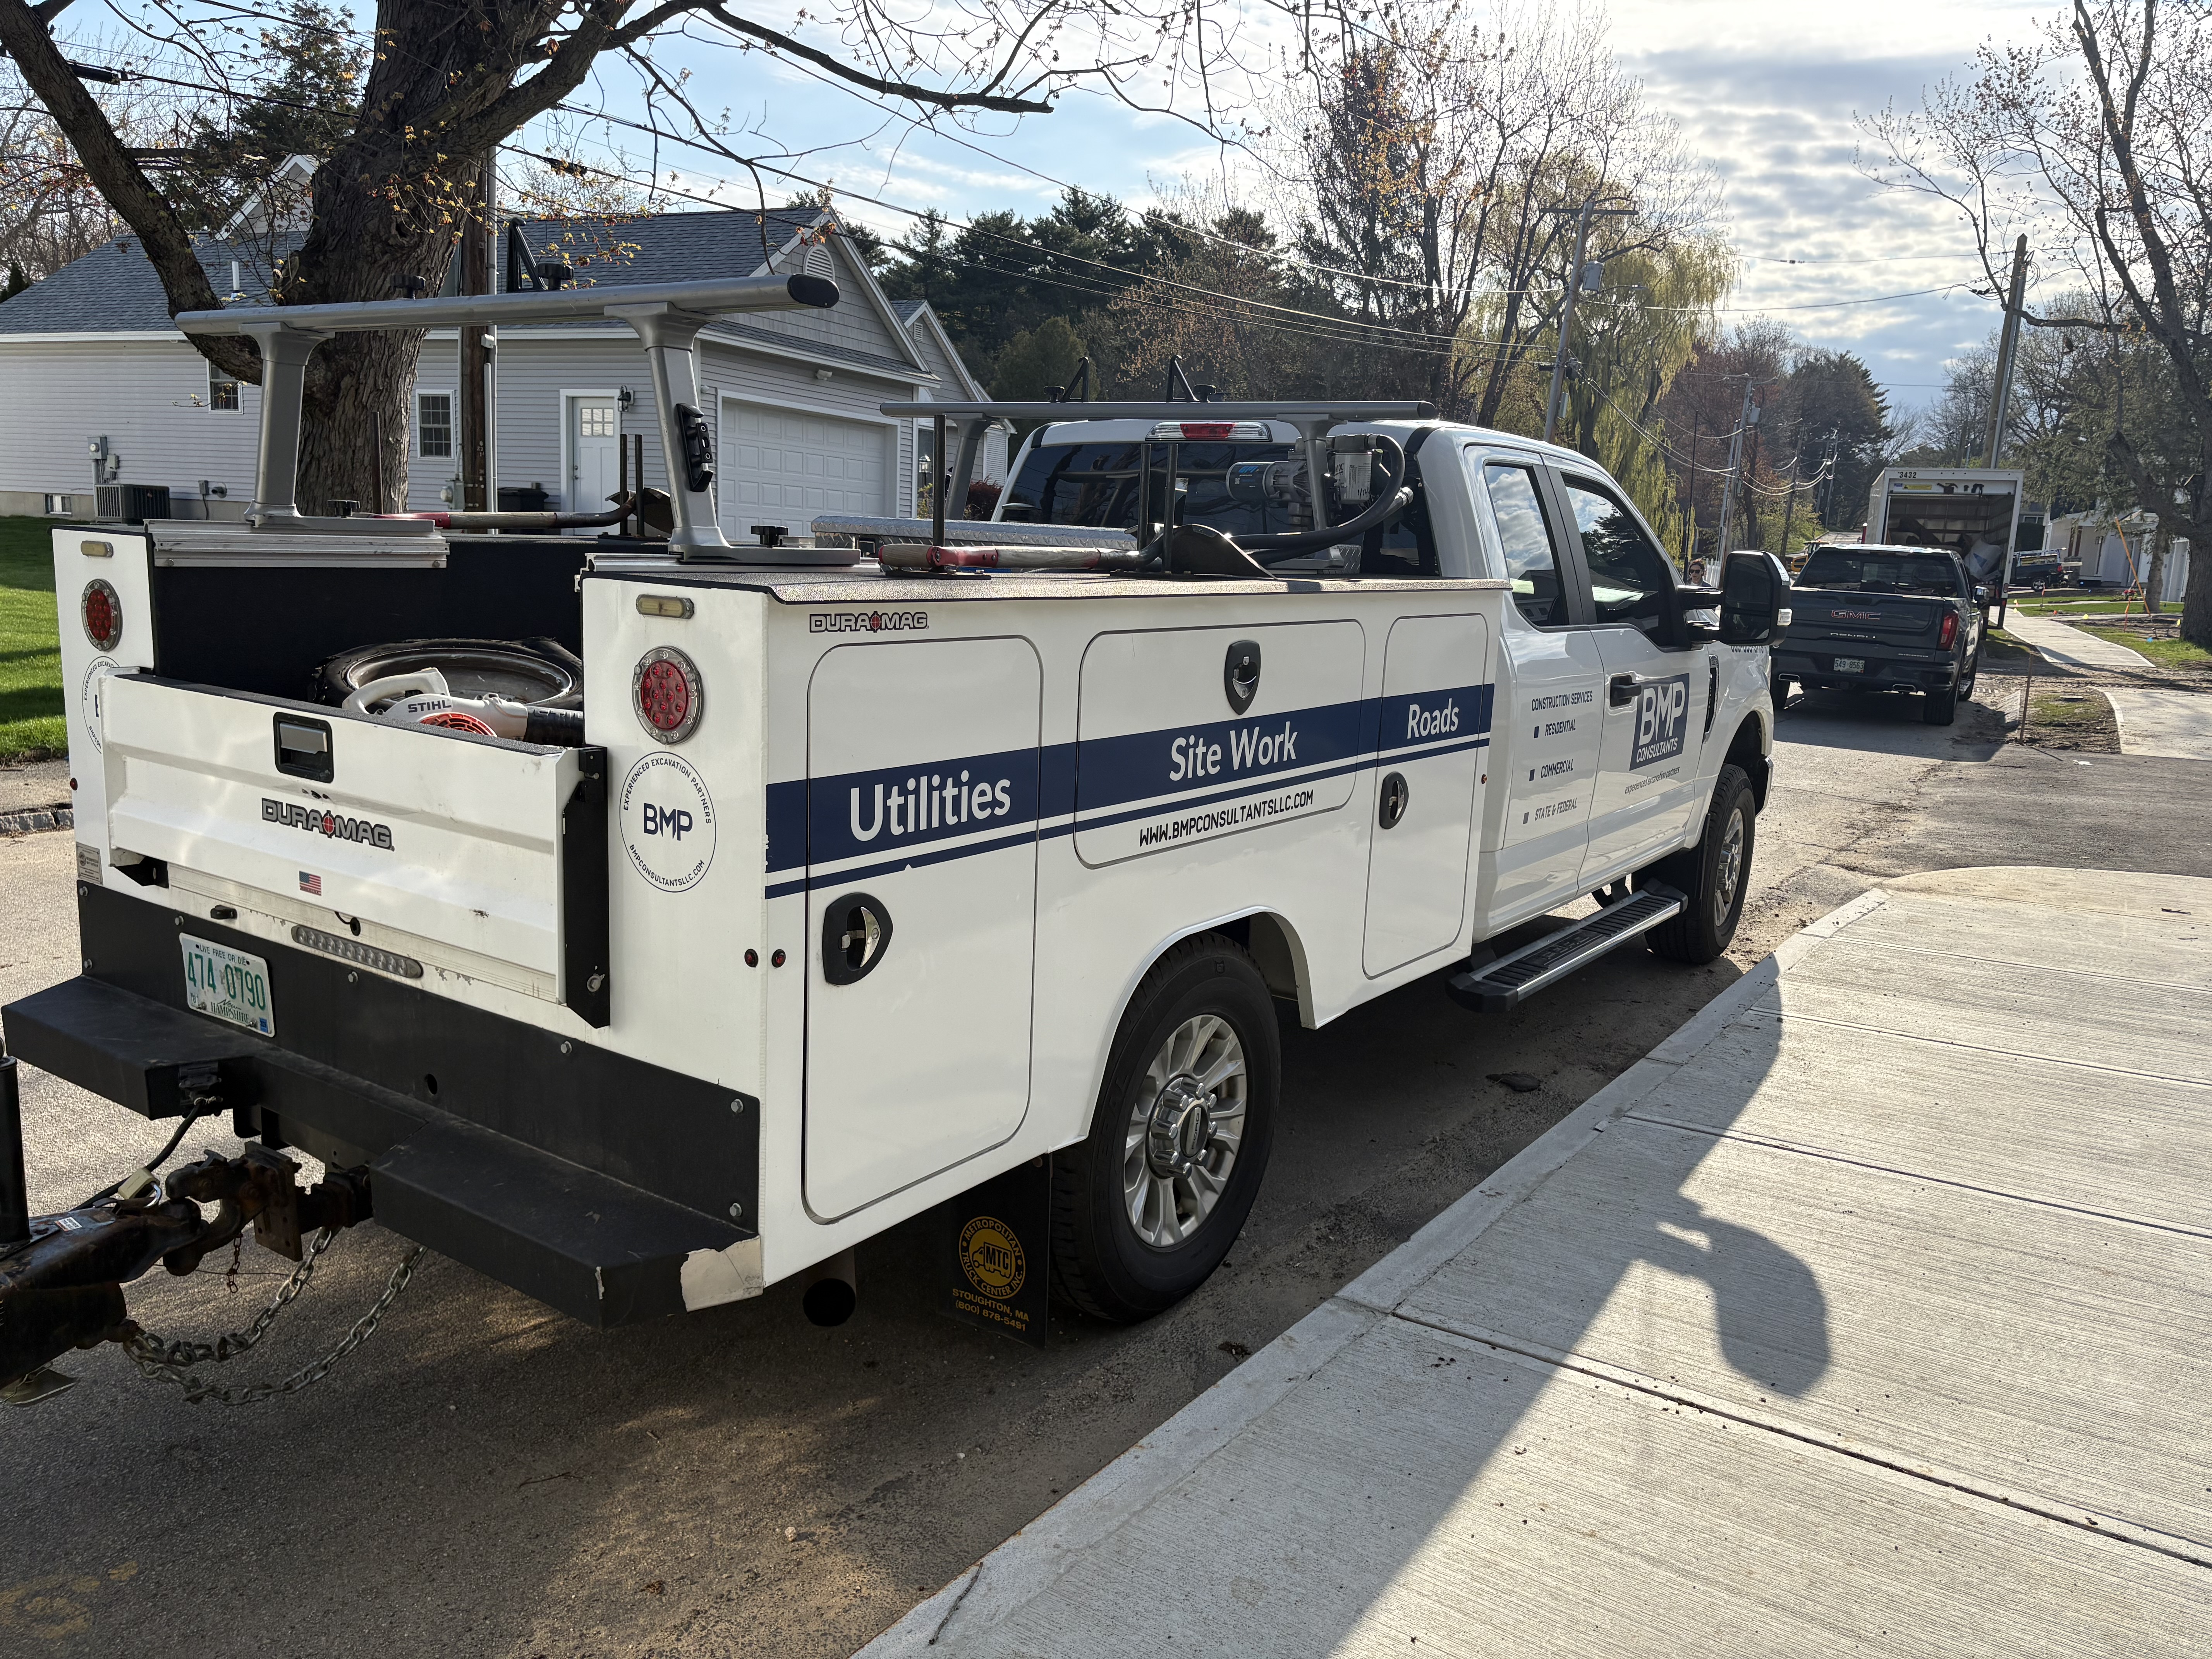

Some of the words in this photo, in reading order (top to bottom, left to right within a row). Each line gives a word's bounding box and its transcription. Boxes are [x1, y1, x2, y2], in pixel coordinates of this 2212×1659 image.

[1831, 609, 1881, 620] GMC
[1835, 659, 1846, 668] 549
[1849, 661, 1864, 670] 8563
[84, 664, 98, 701] EXPERIENCED
[408, 699, 452, 713] STIHL
[1532, 693, 1570, 711] CONSTRUCTION
[1571, 690, 1593, 705] SERVICES
[1638, 681, 1685, 747] BMP
[1407, 698, 1459, 739] Roads
[1545, 719, 1576, 737] RESIDENTIAL
[1170, 735, 1222, 781] Site
[1230, 721, 1298, 771] Work
[1636, 737, 1678, 763] CONSULTANTS
[1541, 759, 1573, 778] COMMERCIAL
[1625, 776, 1648, 795] experienced
[1647, 771, 1666, 785] excavation
[1665, 767, 1680, 780] partners
[623, 762, 650, 811] EXPERIENCED
[651, 757, 692, 779] EXCAVATION
[690, 776, 711, 824] PARTNERS
[850, 770, 1011, 842] Utilities
[644, 802, 693, 841] BMP
[1139, 789, 1314, 847] WWW.BMPCONSULTANTSLLC.COM
[1535, 805, 1552, 821] STATE
[1551, 804, 1556, 816] &
[1556, 798, 1577, 814] FEDERAL
[629, 844, 705, 887] BMPCONSULTANTSLLC.COM
[200, 944, 210, 955] LIVE
[213, 948, 226, 959] FREE
[228, 953, 235, 963] OR
[238, 957, 247, 966] DIE
[188, 951, 217, 994] 474
[225, 963, 266, 1011] 0790
[211, 1001, 250, 1024] HAMPSHIRE
[217, 999, 242, 1011] New
[964, 1219, 1022, 1256] METROPOLITAN
[962, 1251, 982, 1284] TRUCK
[981, 1282, 1012, 1296] CENTER
[1010, 1270, 1023, 1290] INC.
[988, 1245, 1010, 1271] MTC
[952, 1288, 1013, 1316] STOUGHTON,
[1015, 1309, 1030, 1322] MA
[956, 1300, 980, 1315] (800)
[982, 1309, 1026, 1331] 878-5491
